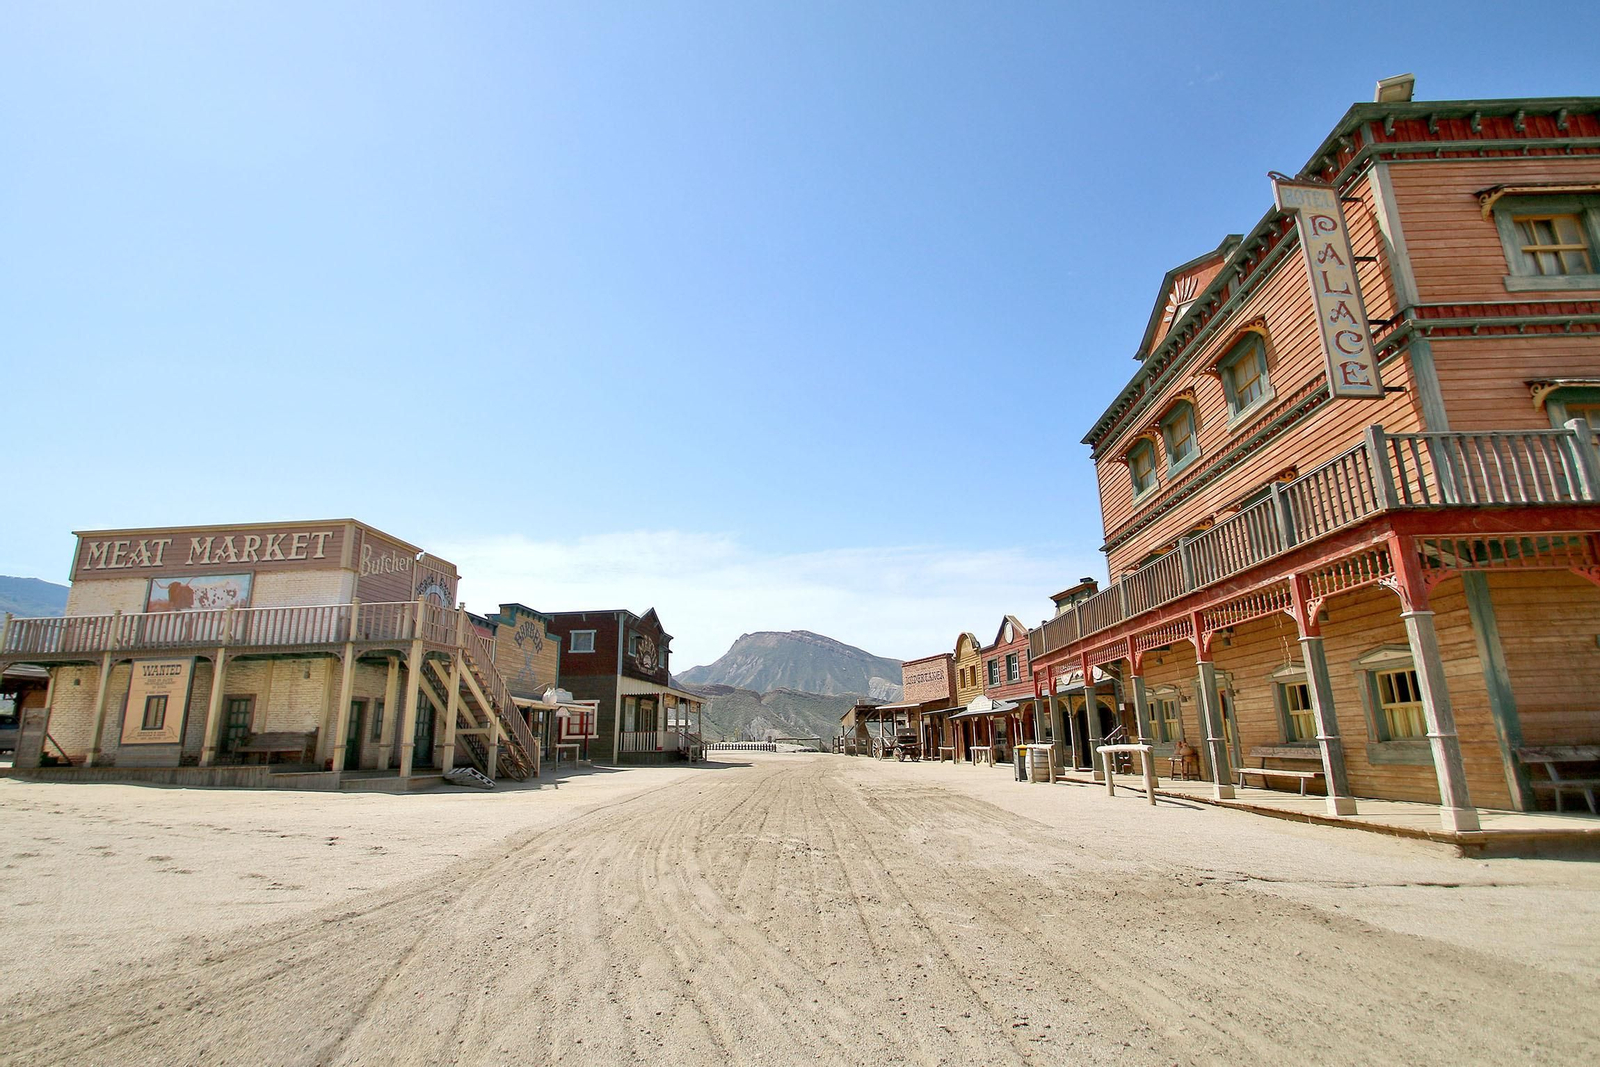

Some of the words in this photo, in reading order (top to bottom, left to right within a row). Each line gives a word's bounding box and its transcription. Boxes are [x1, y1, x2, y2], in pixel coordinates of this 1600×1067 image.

[1283, 188, 1335, 209] HOTEL
[1308, 214, 1373, 388] PALACE
[82, 538, 172, 571] MEAT
[185, 531, 335, 565] MARKET
[359, 543, 413, 577] Butcher
[514, 620, 543, 654] BARBER
[142, 664, 182, 677] WANTED
